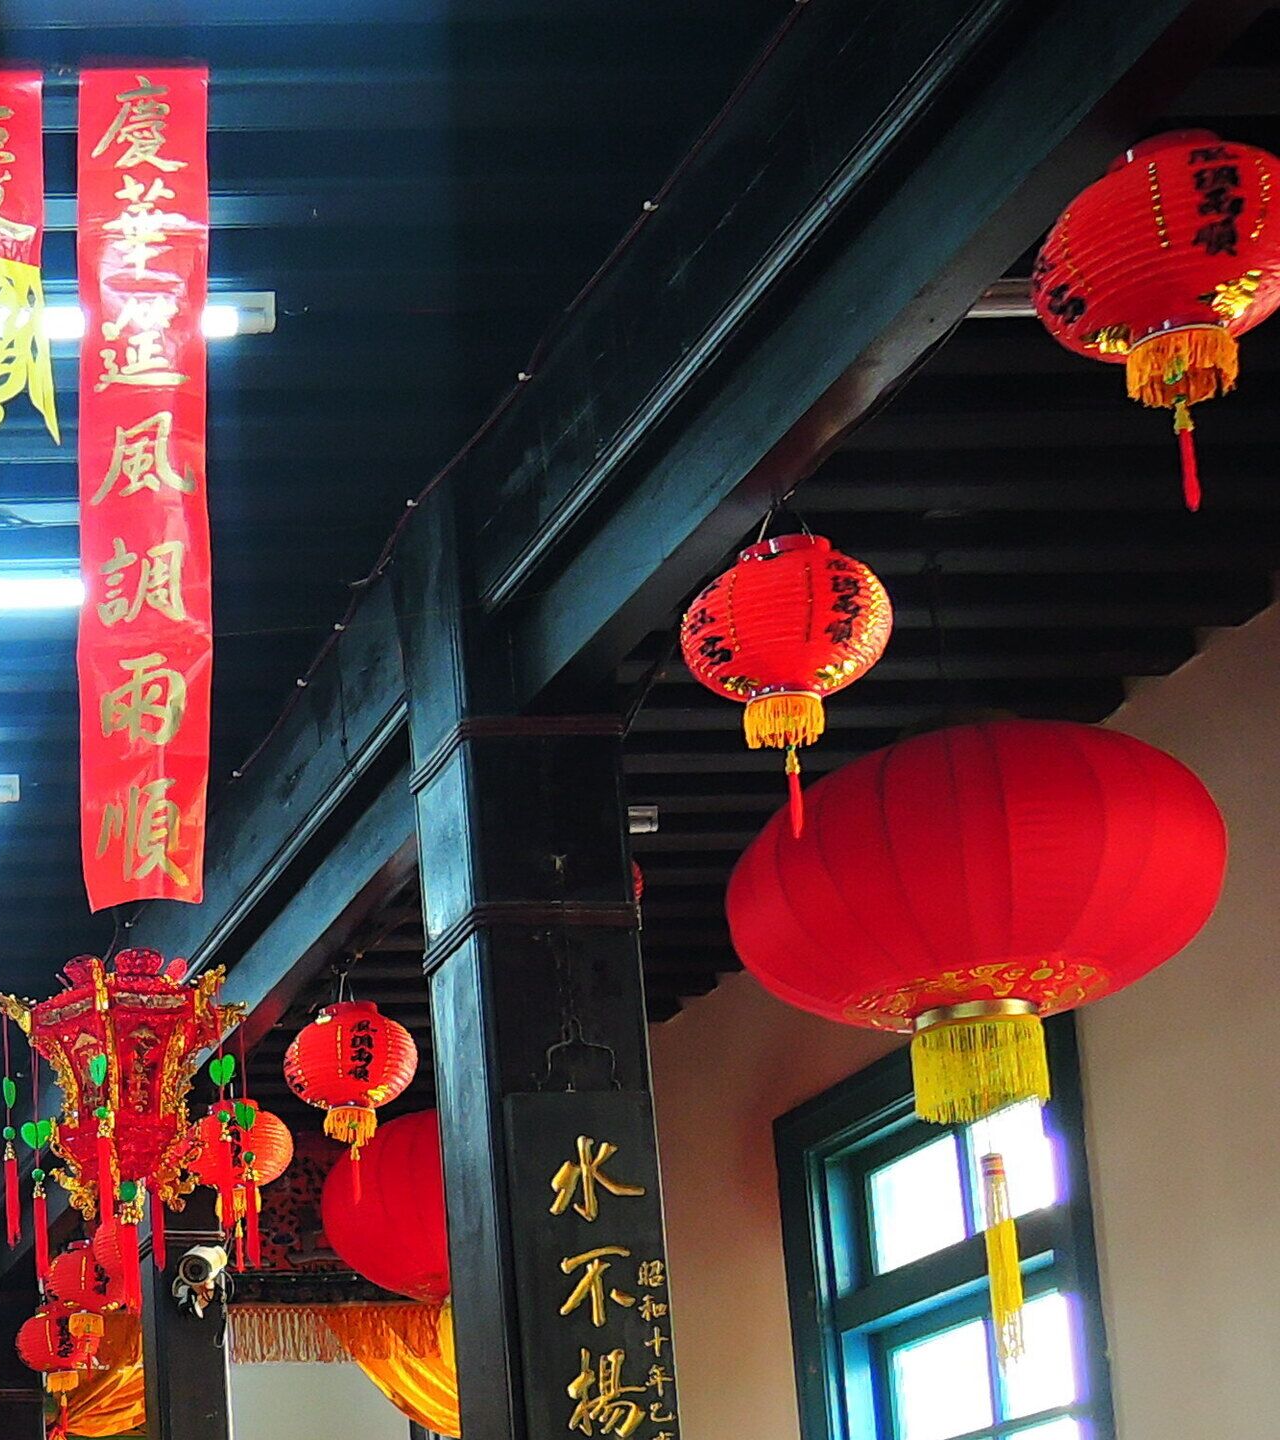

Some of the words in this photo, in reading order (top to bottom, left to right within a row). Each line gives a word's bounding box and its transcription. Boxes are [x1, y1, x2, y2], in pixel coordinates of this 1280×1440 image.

[93, 77, 195, 887] 慶華筵風調雨順
